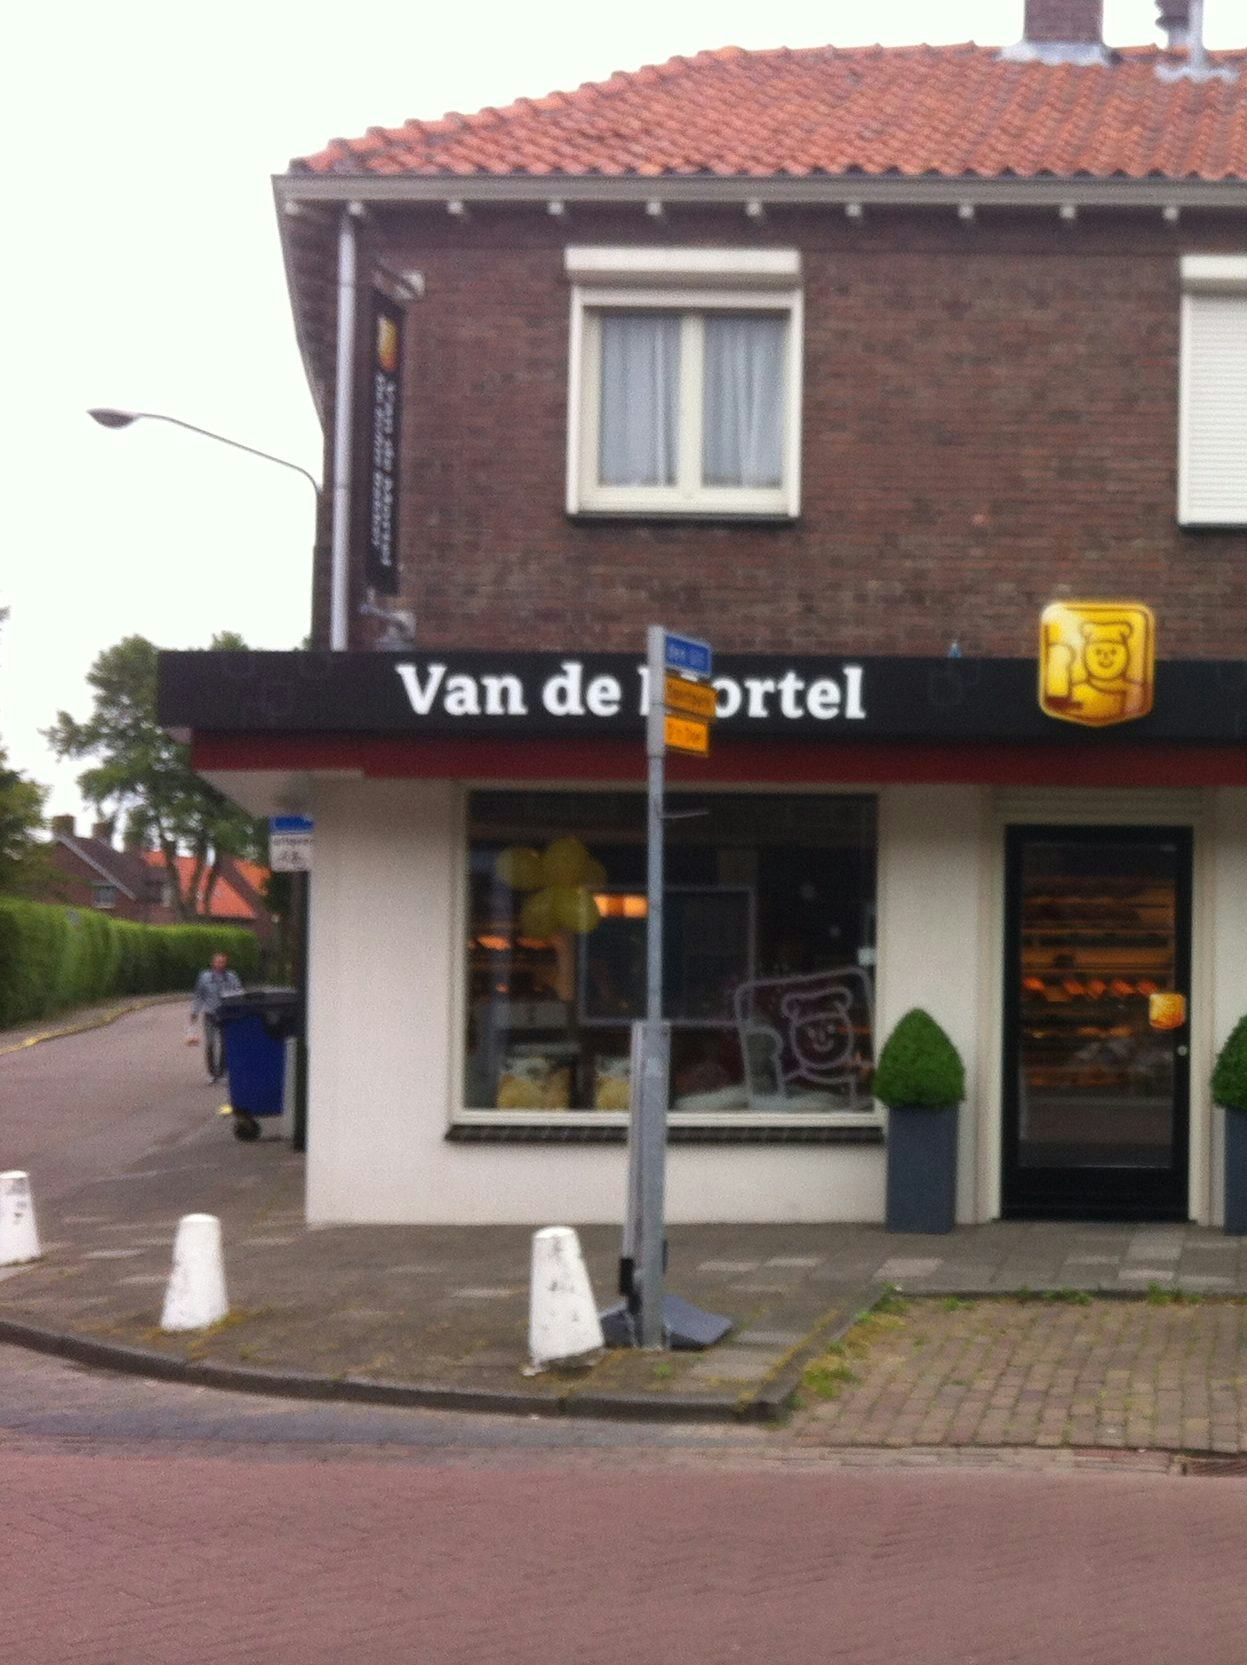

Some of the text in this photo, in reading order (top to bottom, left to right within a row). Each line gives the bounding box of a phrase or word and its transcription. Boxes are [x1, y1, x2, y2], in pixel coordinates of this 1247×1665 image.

[395, 663, 528, 716] Van
[542, 661, 622, 716] de
[637, 664, 867, 719] ortel
